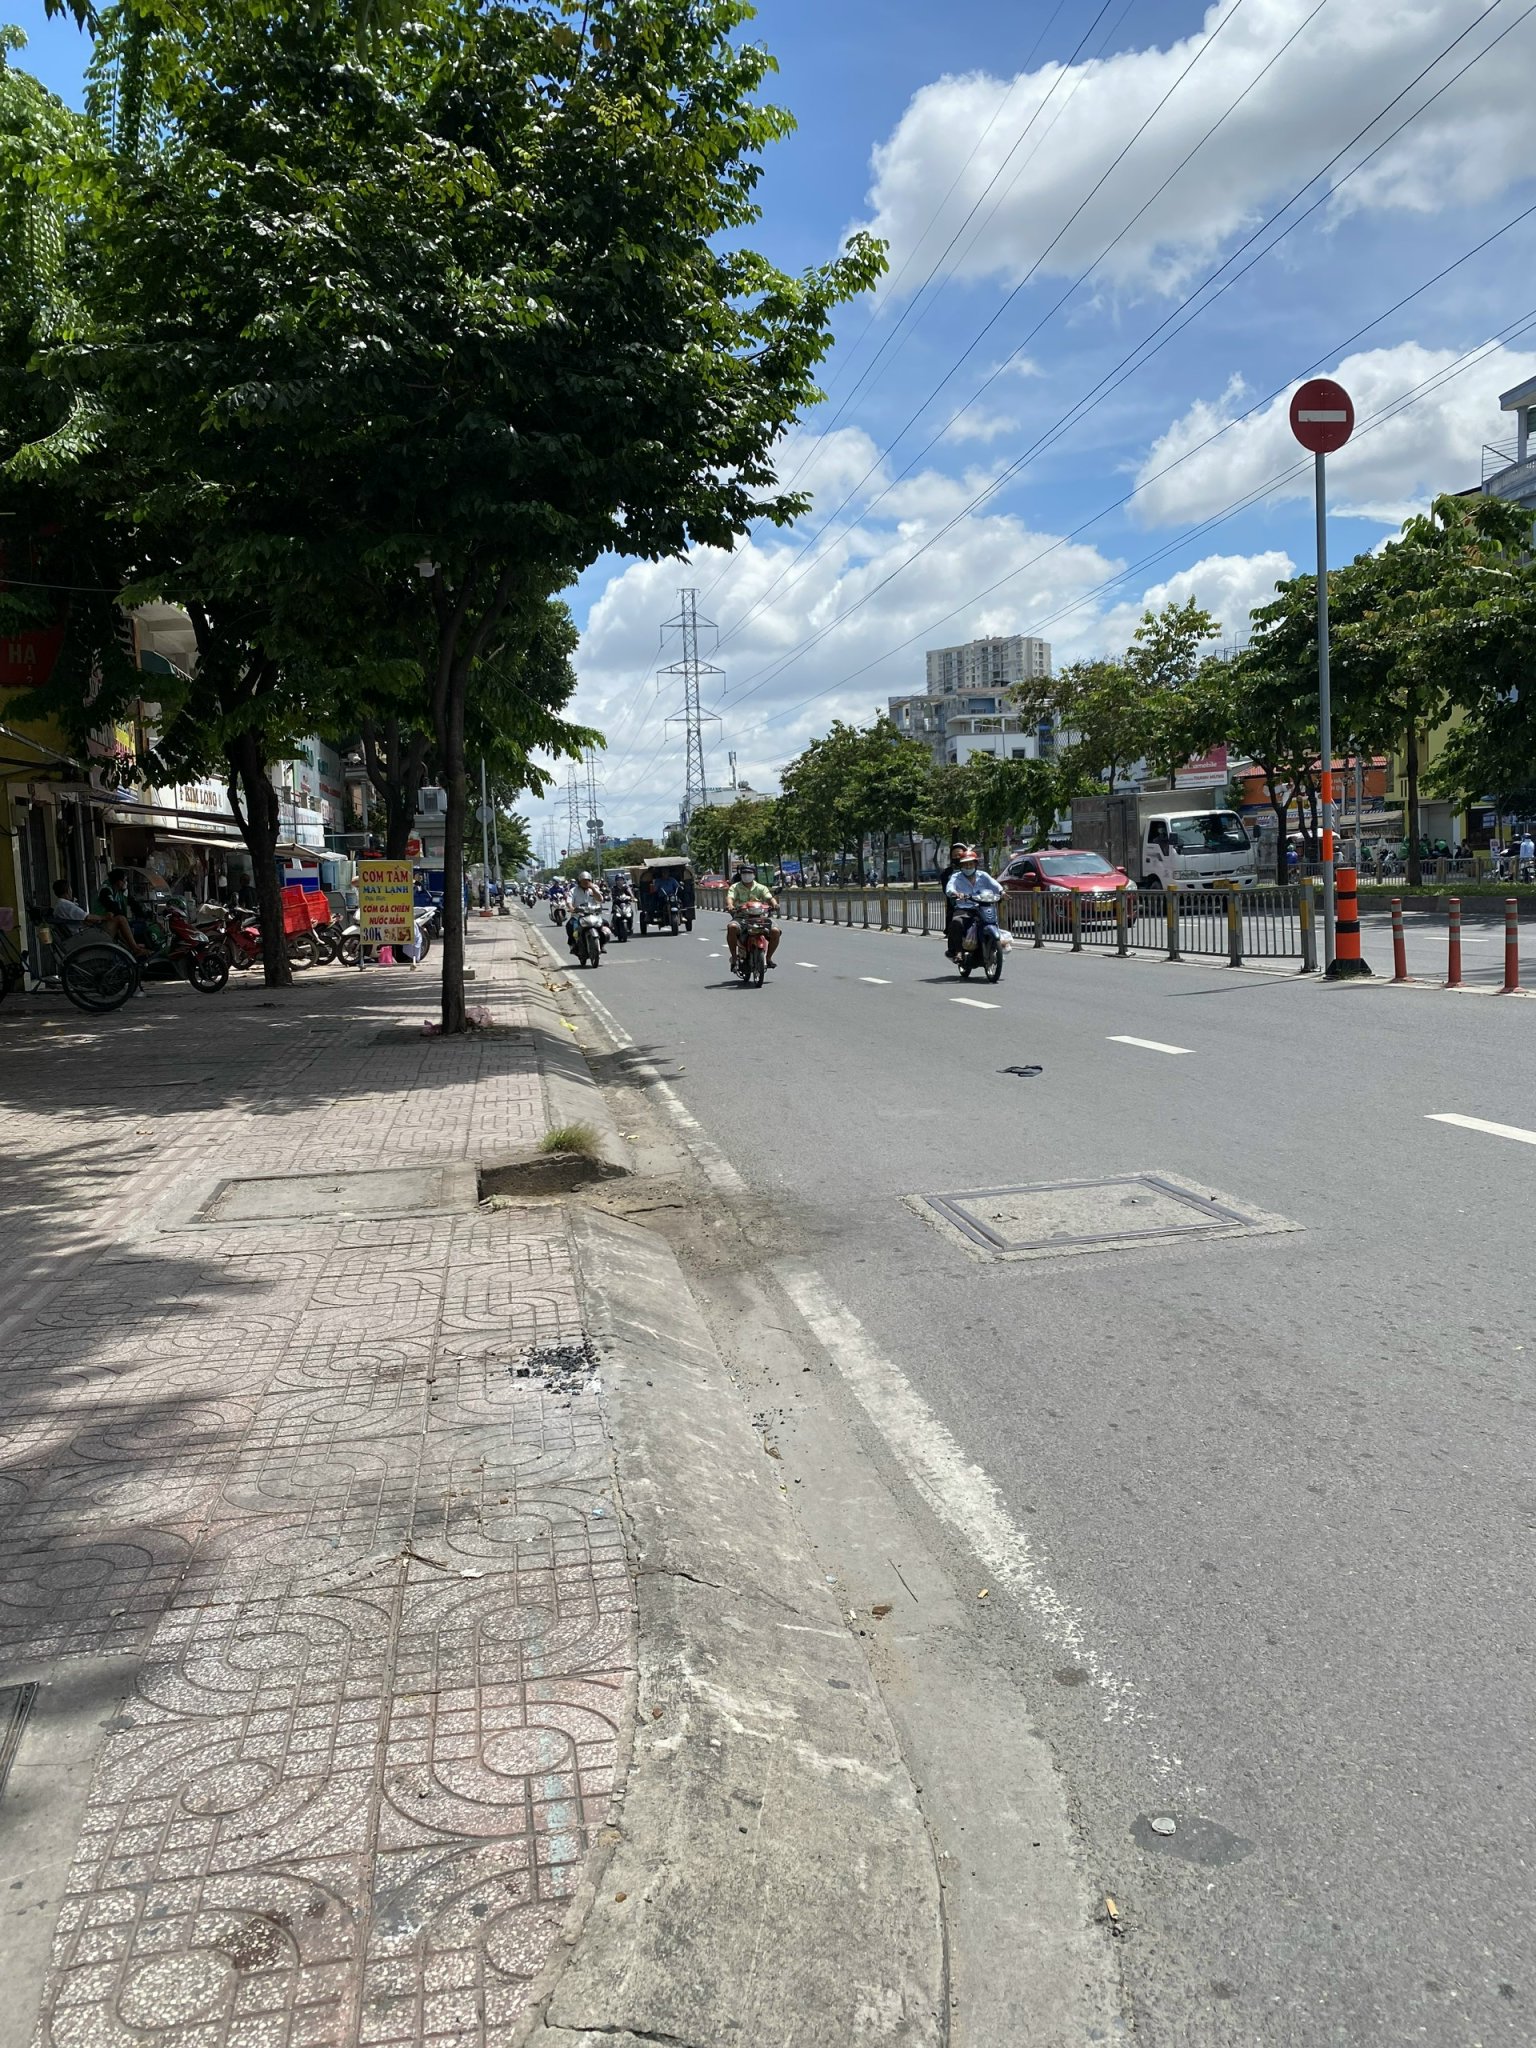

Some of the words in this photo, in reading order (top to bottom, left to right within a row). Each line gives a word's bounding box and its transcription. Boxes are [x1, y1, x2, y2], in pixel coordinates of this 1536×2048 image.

[185, 786, 199, 803] KIM
[200, 789, 217, 807] LONG
[362, 869, 384, 882] CƠM
[386, 865, 408, 882] TẤM
[363, 904, 378, 912] CƠM
[363, 927, 382, 941] 30K
